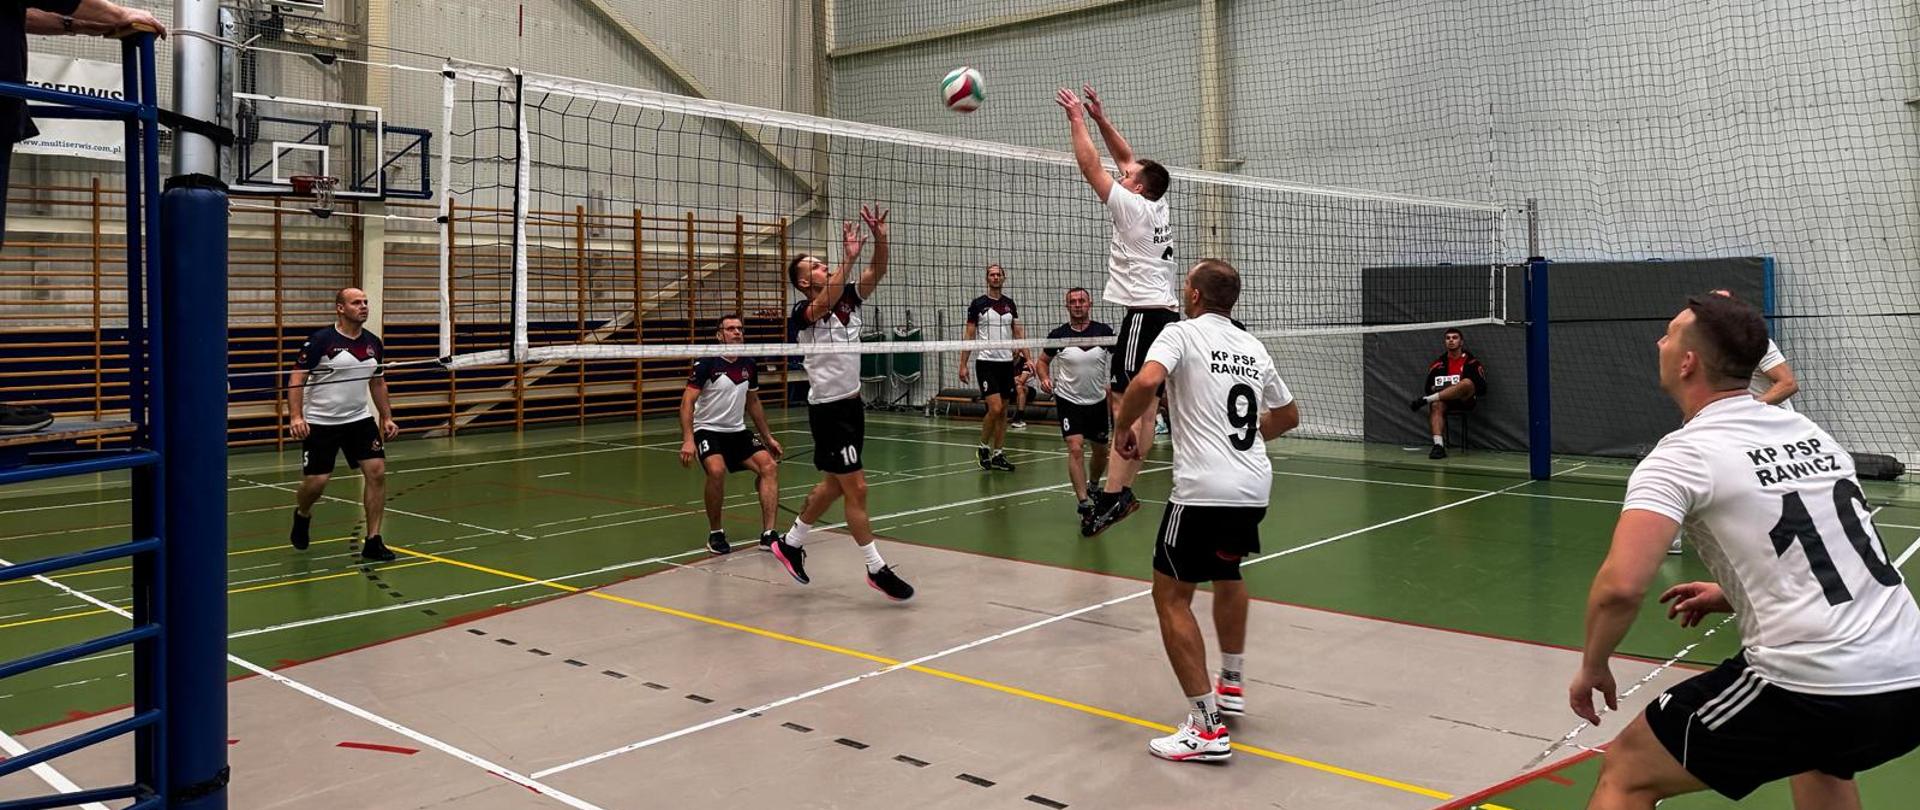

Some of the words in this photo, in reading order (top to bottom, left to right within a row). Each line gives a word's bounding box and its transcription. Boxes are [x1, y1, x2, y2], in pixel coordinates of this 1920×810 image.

[1211, 350, 1229, 361] KP
[1232, 354, 1256, 366] PSP
[1210, 363, 1260, 380] RAWICZ
[983, 380, 988, 392] 9
[1063, 417, 1070, 431] 8
[1227, 383, 1258, 452] 9
[698, 439, 710, 456] 13
[840, 444, 858, 466] 10
[1747, 447, 1778, 466] KP
[1782, 438, 1822, 460] PSP
[303, 450, 310, 467] 5
[1755, 455, 1841, 487] RAWICZ
[1768, 478, 1902, 607] 10
